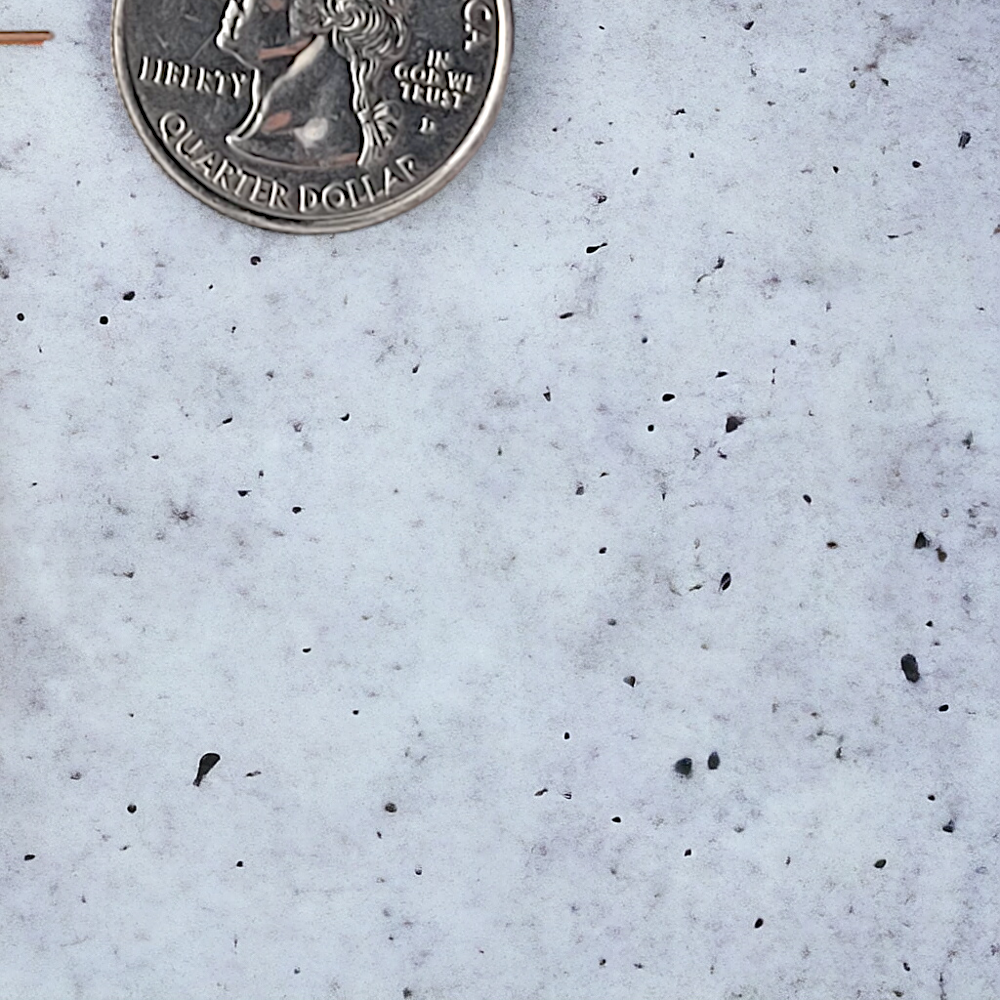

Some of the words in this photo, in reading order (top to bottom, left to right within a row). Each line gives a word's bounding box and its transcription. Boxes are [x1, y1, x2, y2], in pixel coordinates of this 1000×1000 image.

[138, 55, 247, 99] LIBERTY
[426, 49, 452, 70] IN
[399, 80, 463, 110] TRUST
[158, 111, 290, 211] QUARTER
[299, 154, 421, 213] DOLLAR
